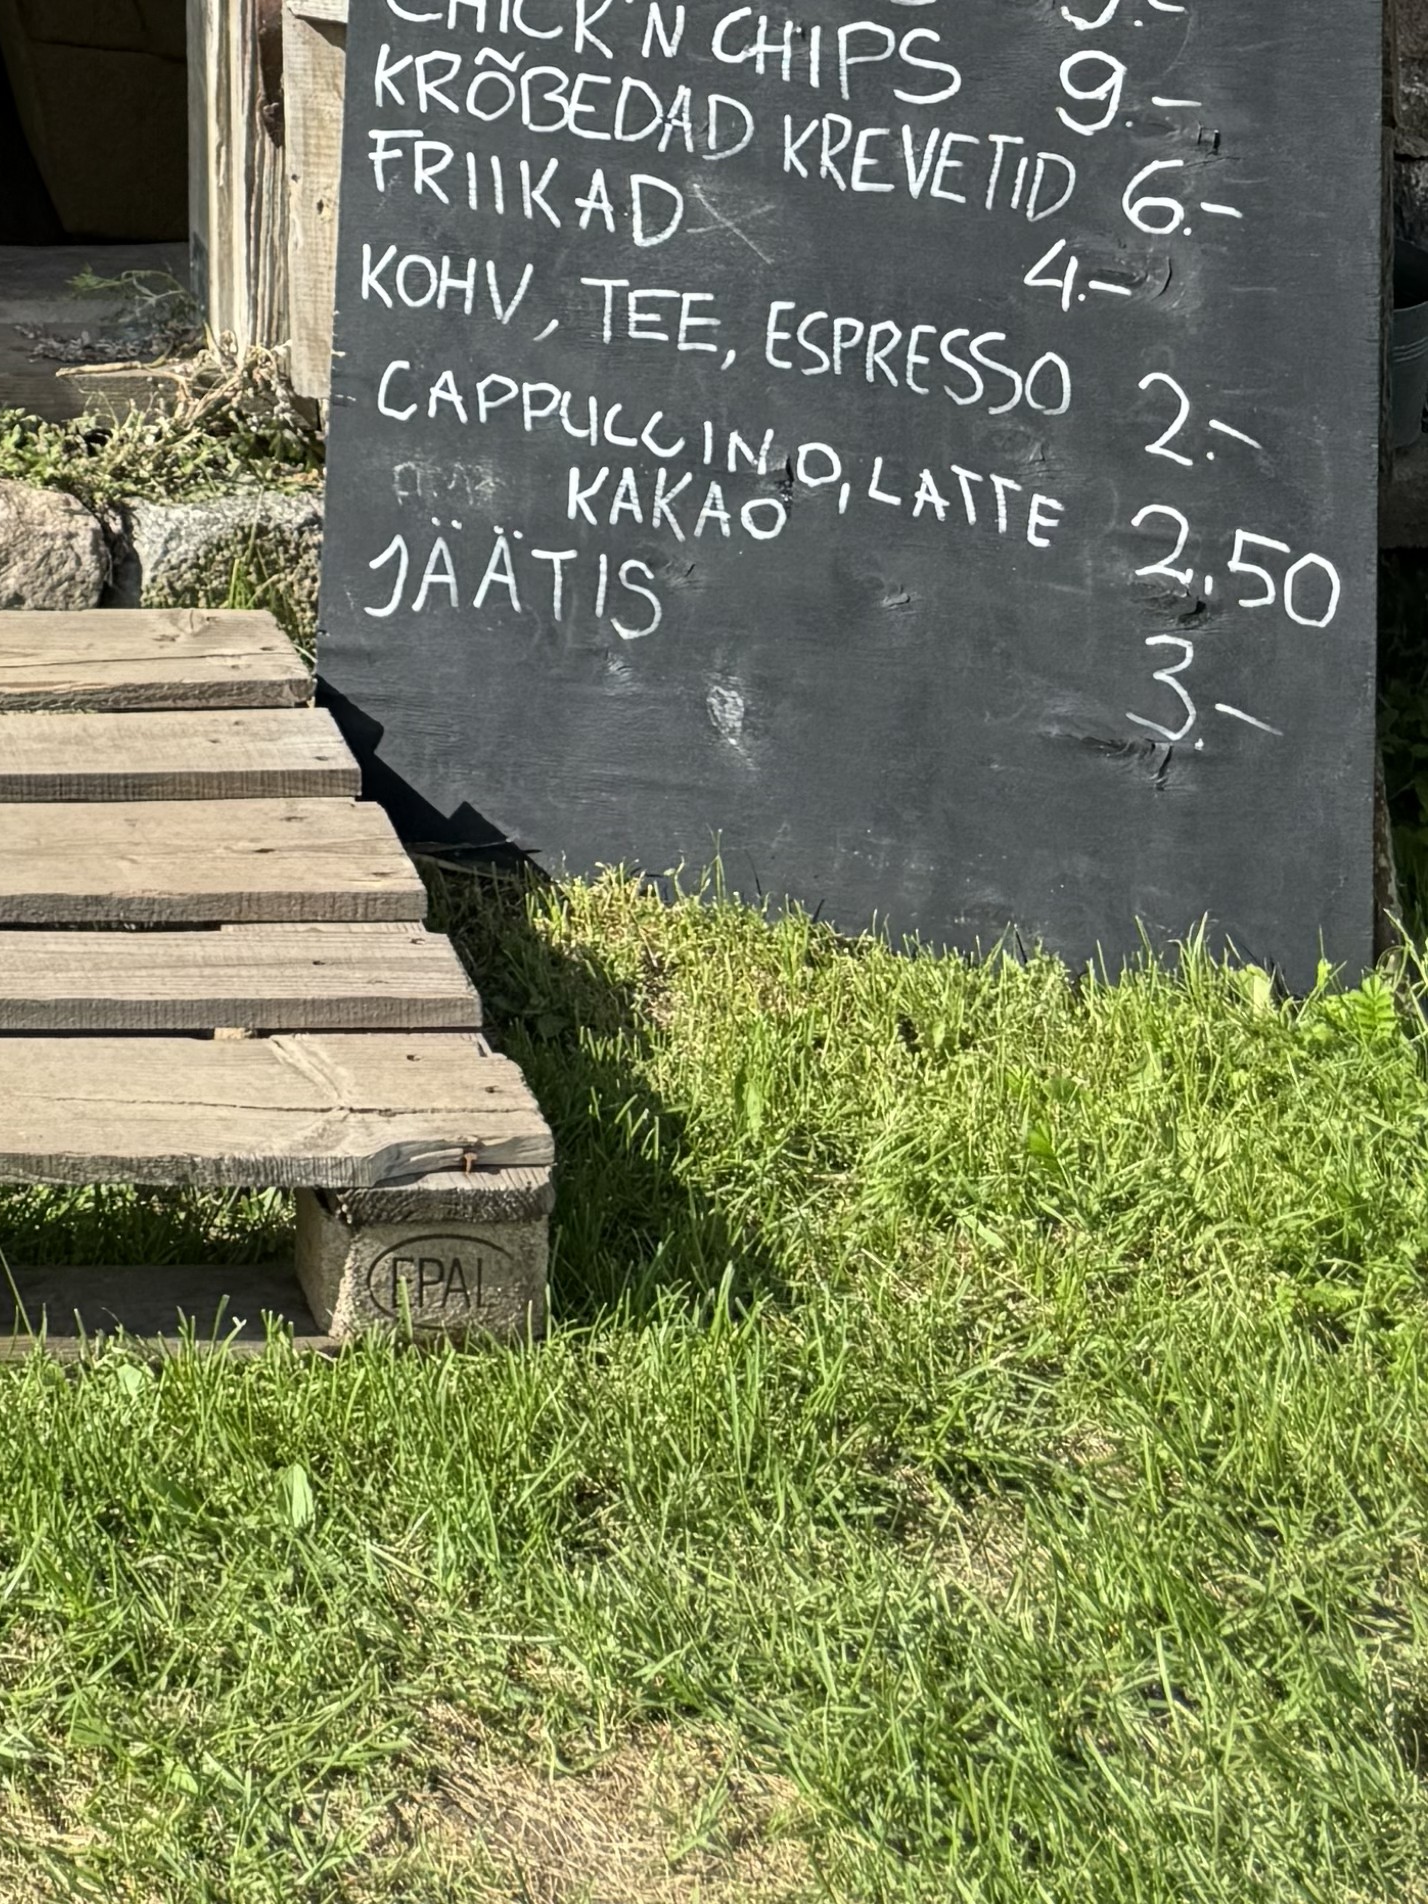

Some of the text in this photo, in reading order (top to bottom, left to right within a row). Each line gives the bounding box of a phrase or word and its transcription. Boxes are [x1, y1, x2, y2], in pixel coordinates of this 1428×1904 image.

[711, 6, 963, 105] CHIPS
[1054, 50, 1204, 137] 9.-
[373, 42, 1244, 236] KRÕBEDAD KREVETID 6.-
[368, 129, 1132, 312] FRIIKAD 4.-
[580, 277, 737, 372] TEE,
[765, 300, 1072, 416] ESPRESSO
[1138, 371, 1263, 467] 2.-
[567, 466, 787, 542] KAKAO
[363, 516, 662, 640] JÄÄTIS
[1124, 633, 1285, 750] 3.-
